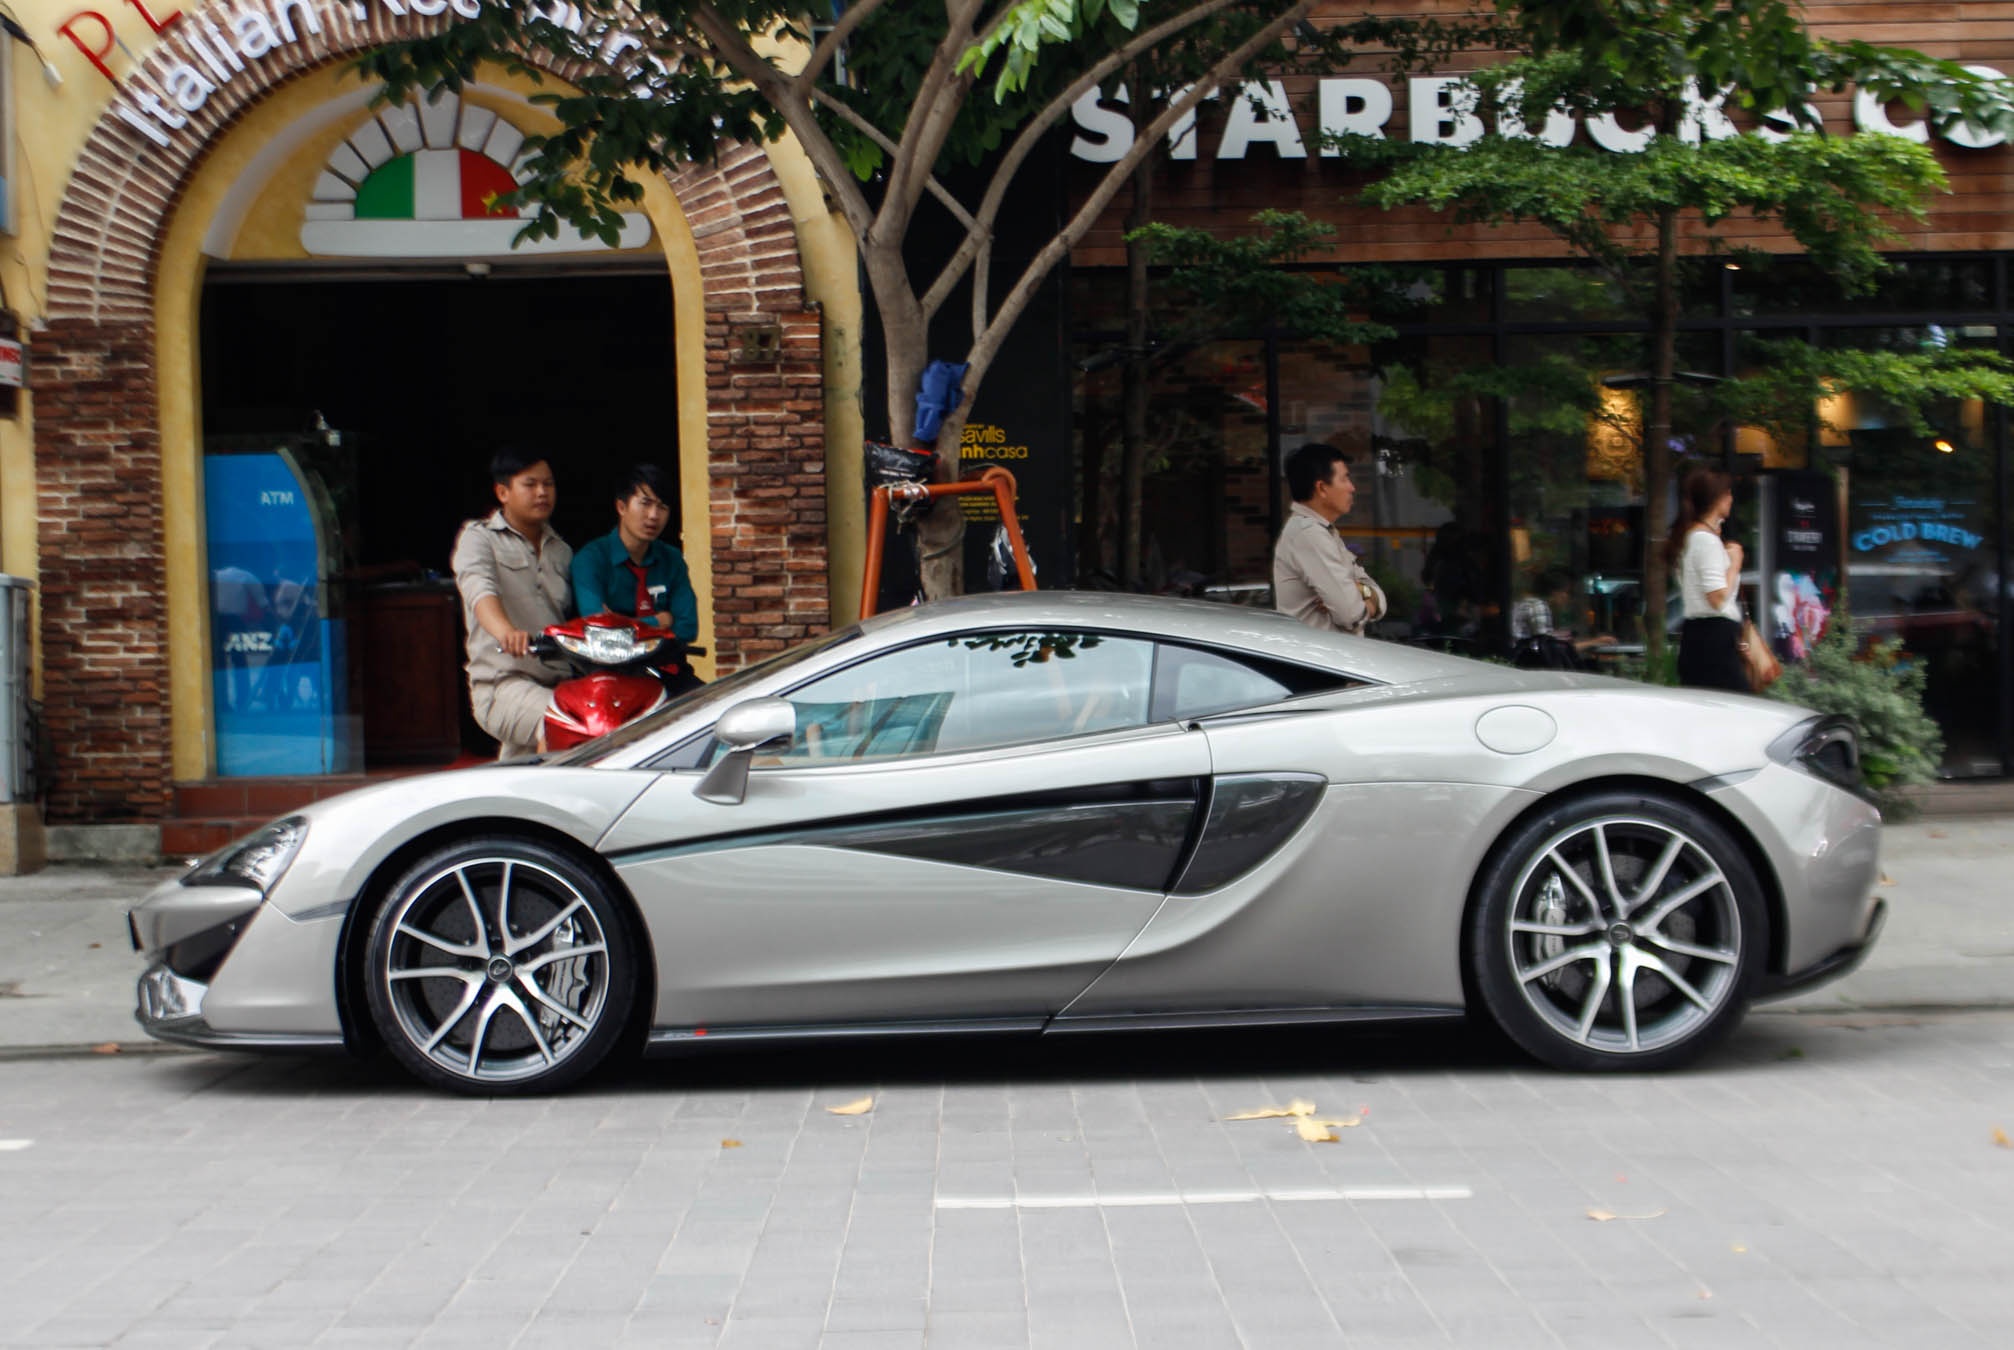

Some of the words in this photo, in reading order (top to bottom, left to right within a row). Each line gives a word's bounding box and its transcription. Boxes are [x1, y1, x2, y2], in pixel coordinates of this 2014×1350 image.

[117, 0, 321, 148] Italian
[261, 491, 294, 505] ATM
[1853, 521, 1917, 551] COLD
[1920, 521, 1984, 549] BREW
[224, 632, 273, 651] ANZ
